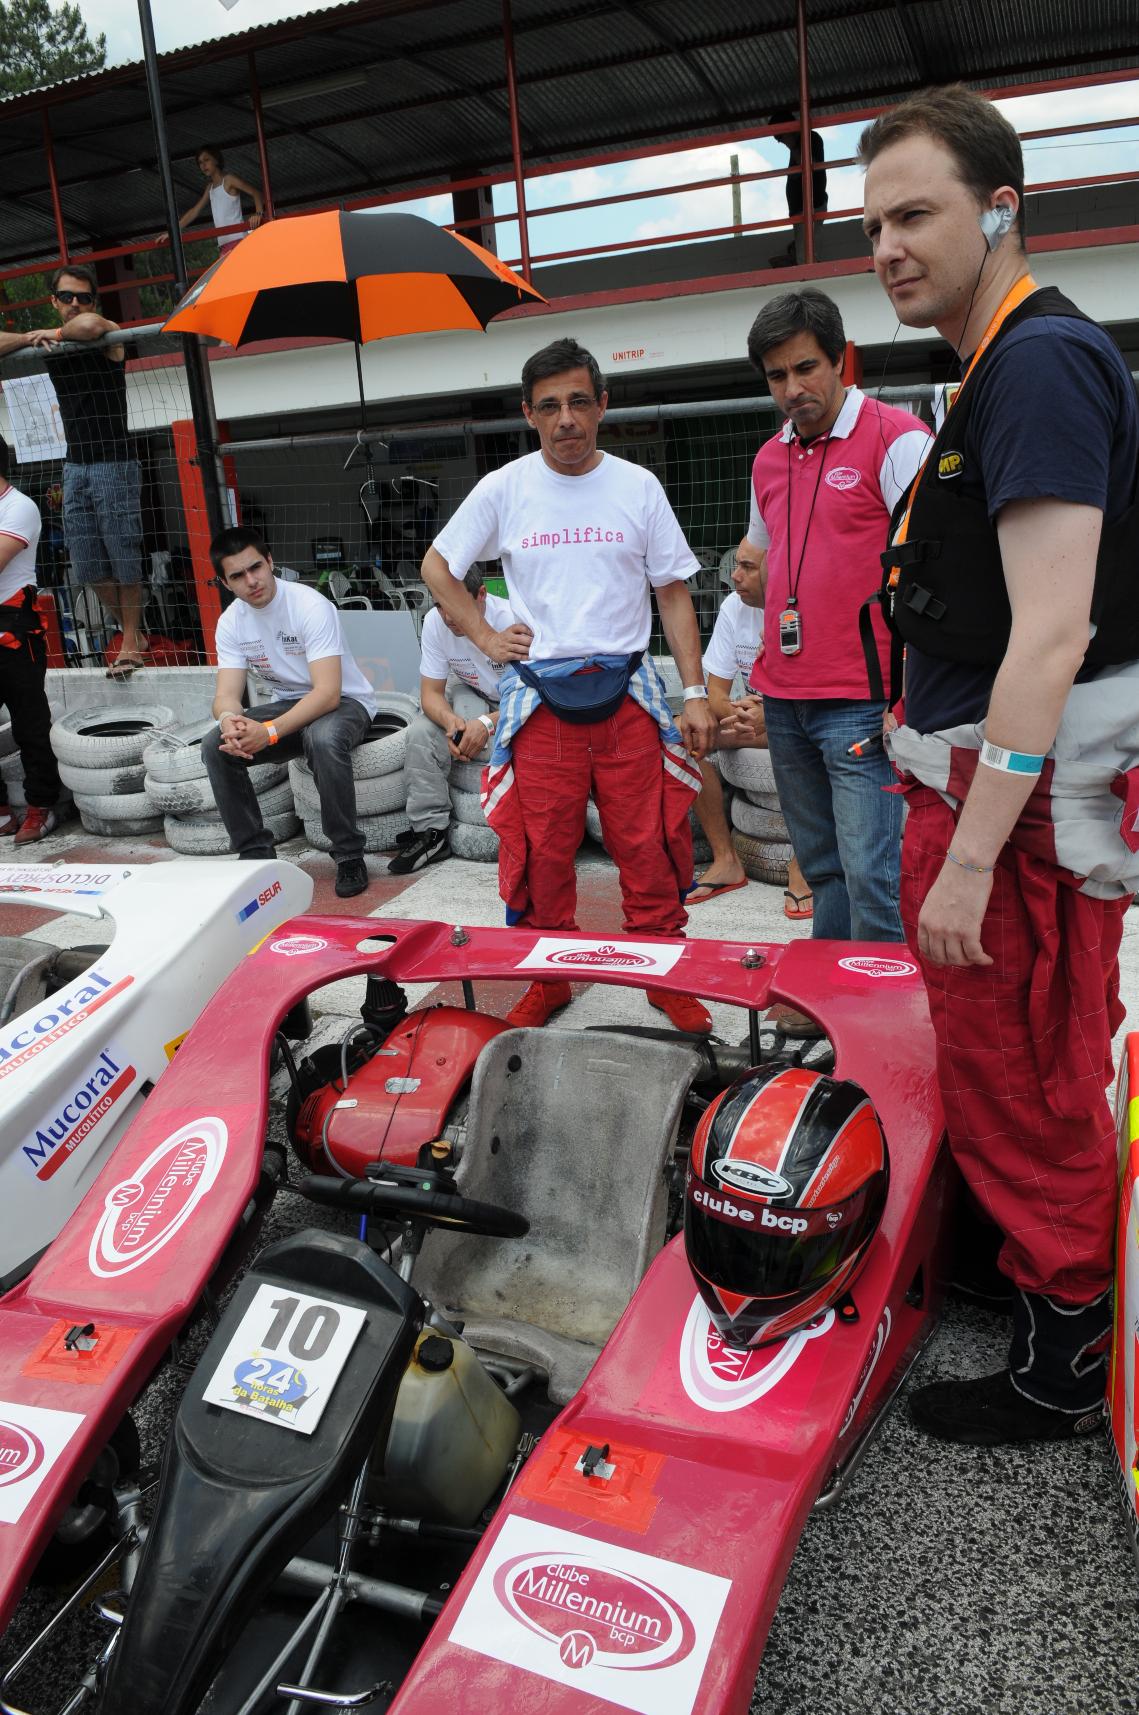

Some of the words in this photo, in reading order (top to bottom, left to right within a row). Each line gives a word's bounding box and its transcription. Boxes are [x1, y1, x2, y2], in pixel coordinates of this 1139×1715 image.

[612, 348, 645, 361] UNITRIP
[521, 527, 624, 549] simplifica
[259, 881, 282, 905] SEUR
[22, 1052, 120, 1168] Mucoral
[65, 1096, 113, 1152] MUCOLÍTICO
[183, 1154, 206, 1186] clube
[721, 1165, 780, 1187] KBC
[124, 1141, 206, 1246] Millennium
[121, 1212, 141, 1231] bcp
[693, 1191, 754, 1222] clube
[761, 1209, 808, 1235] bcp
[261, 1296, 341, 1362] 10
[242, 1358, 294, 1394] 24
[232, 1386, 248, 1398] da
[250, 1388, 294, 1413] Batalha
[546, 1563, 590, 1586] clube
[518, 1568, 662, 1637] Millennium
[609, 1626, 635, 1646] bcp
